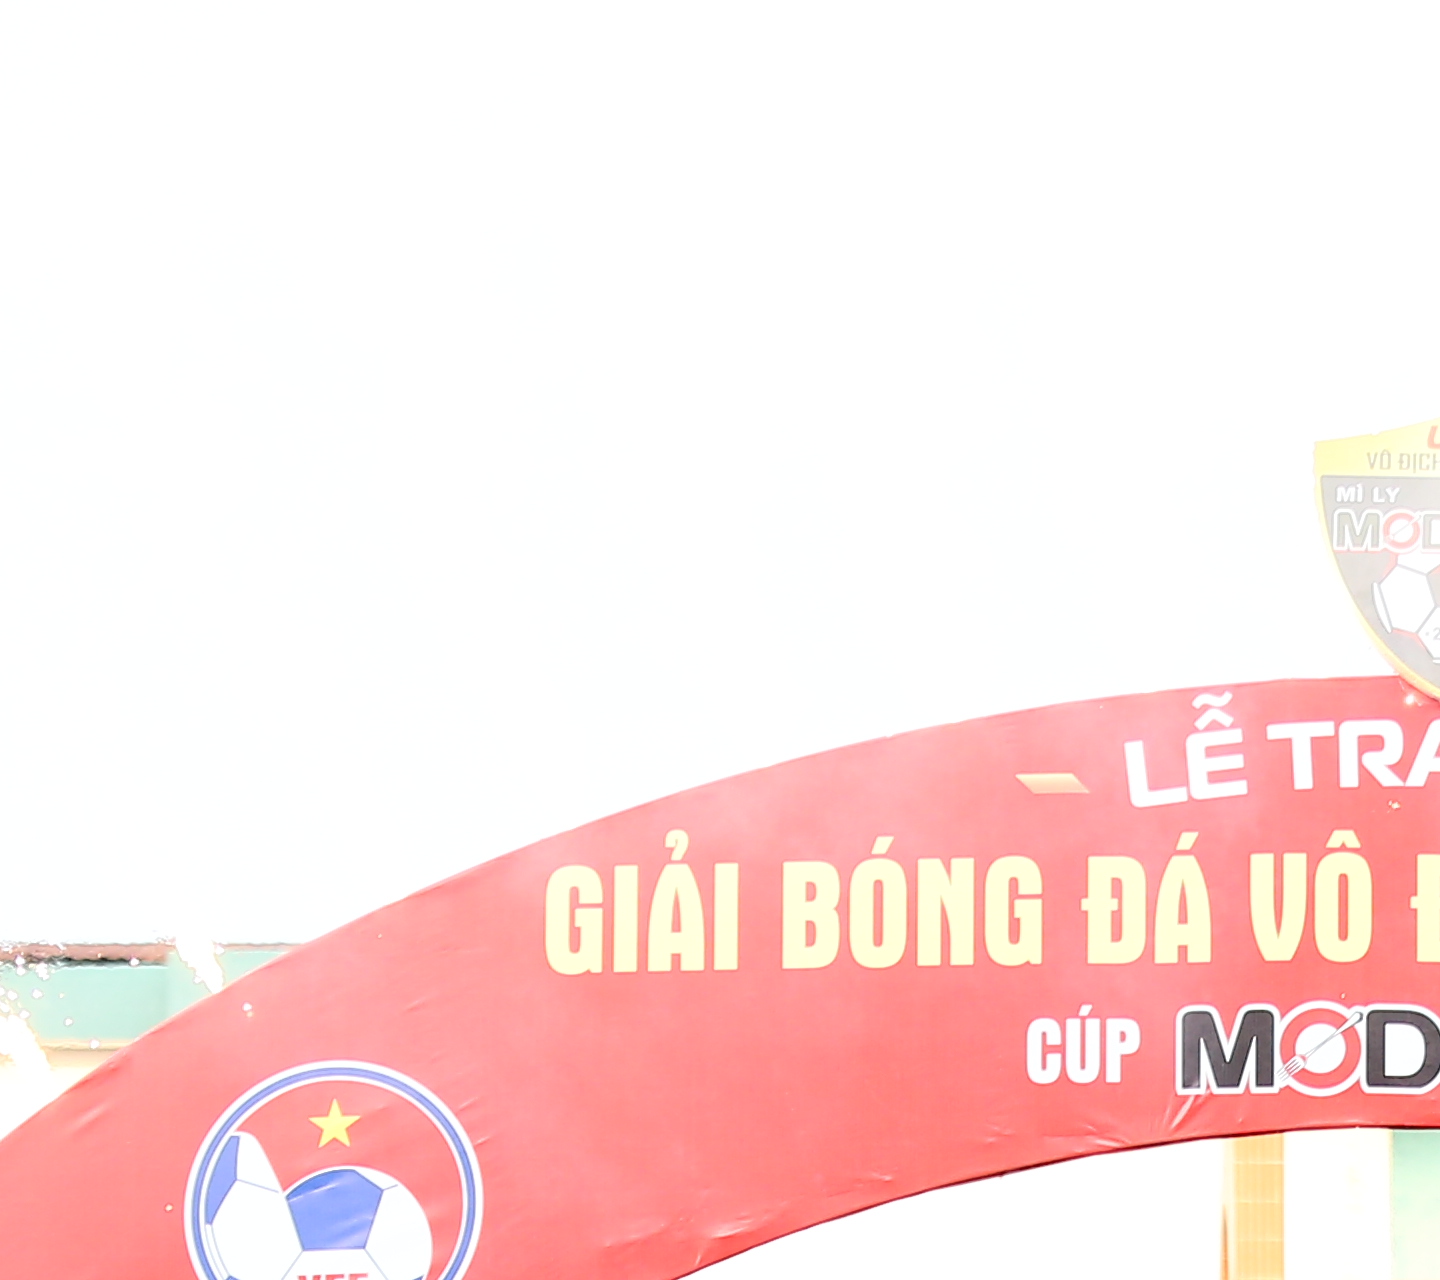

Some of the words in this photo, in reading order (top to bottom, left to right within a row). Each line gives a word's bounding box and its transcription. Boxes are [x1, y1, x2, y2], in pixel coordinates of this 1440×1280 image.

[1336, 483, 1364, 503] MÌ
[1373, 486, 1401, 503] LY
[1367, 449, 1391, 470] VÔ
[1123, 692, 1249, 808] LỄ
[544, 829, 740, 975] GIẢI
[781, 836, 1044, 970] BÓNG
[1081, 831, 1213, 965] ĐÁ
[1249, 829, 1373, 964] VÔ
[1025, 1004, 1141, 1085] CÚP
